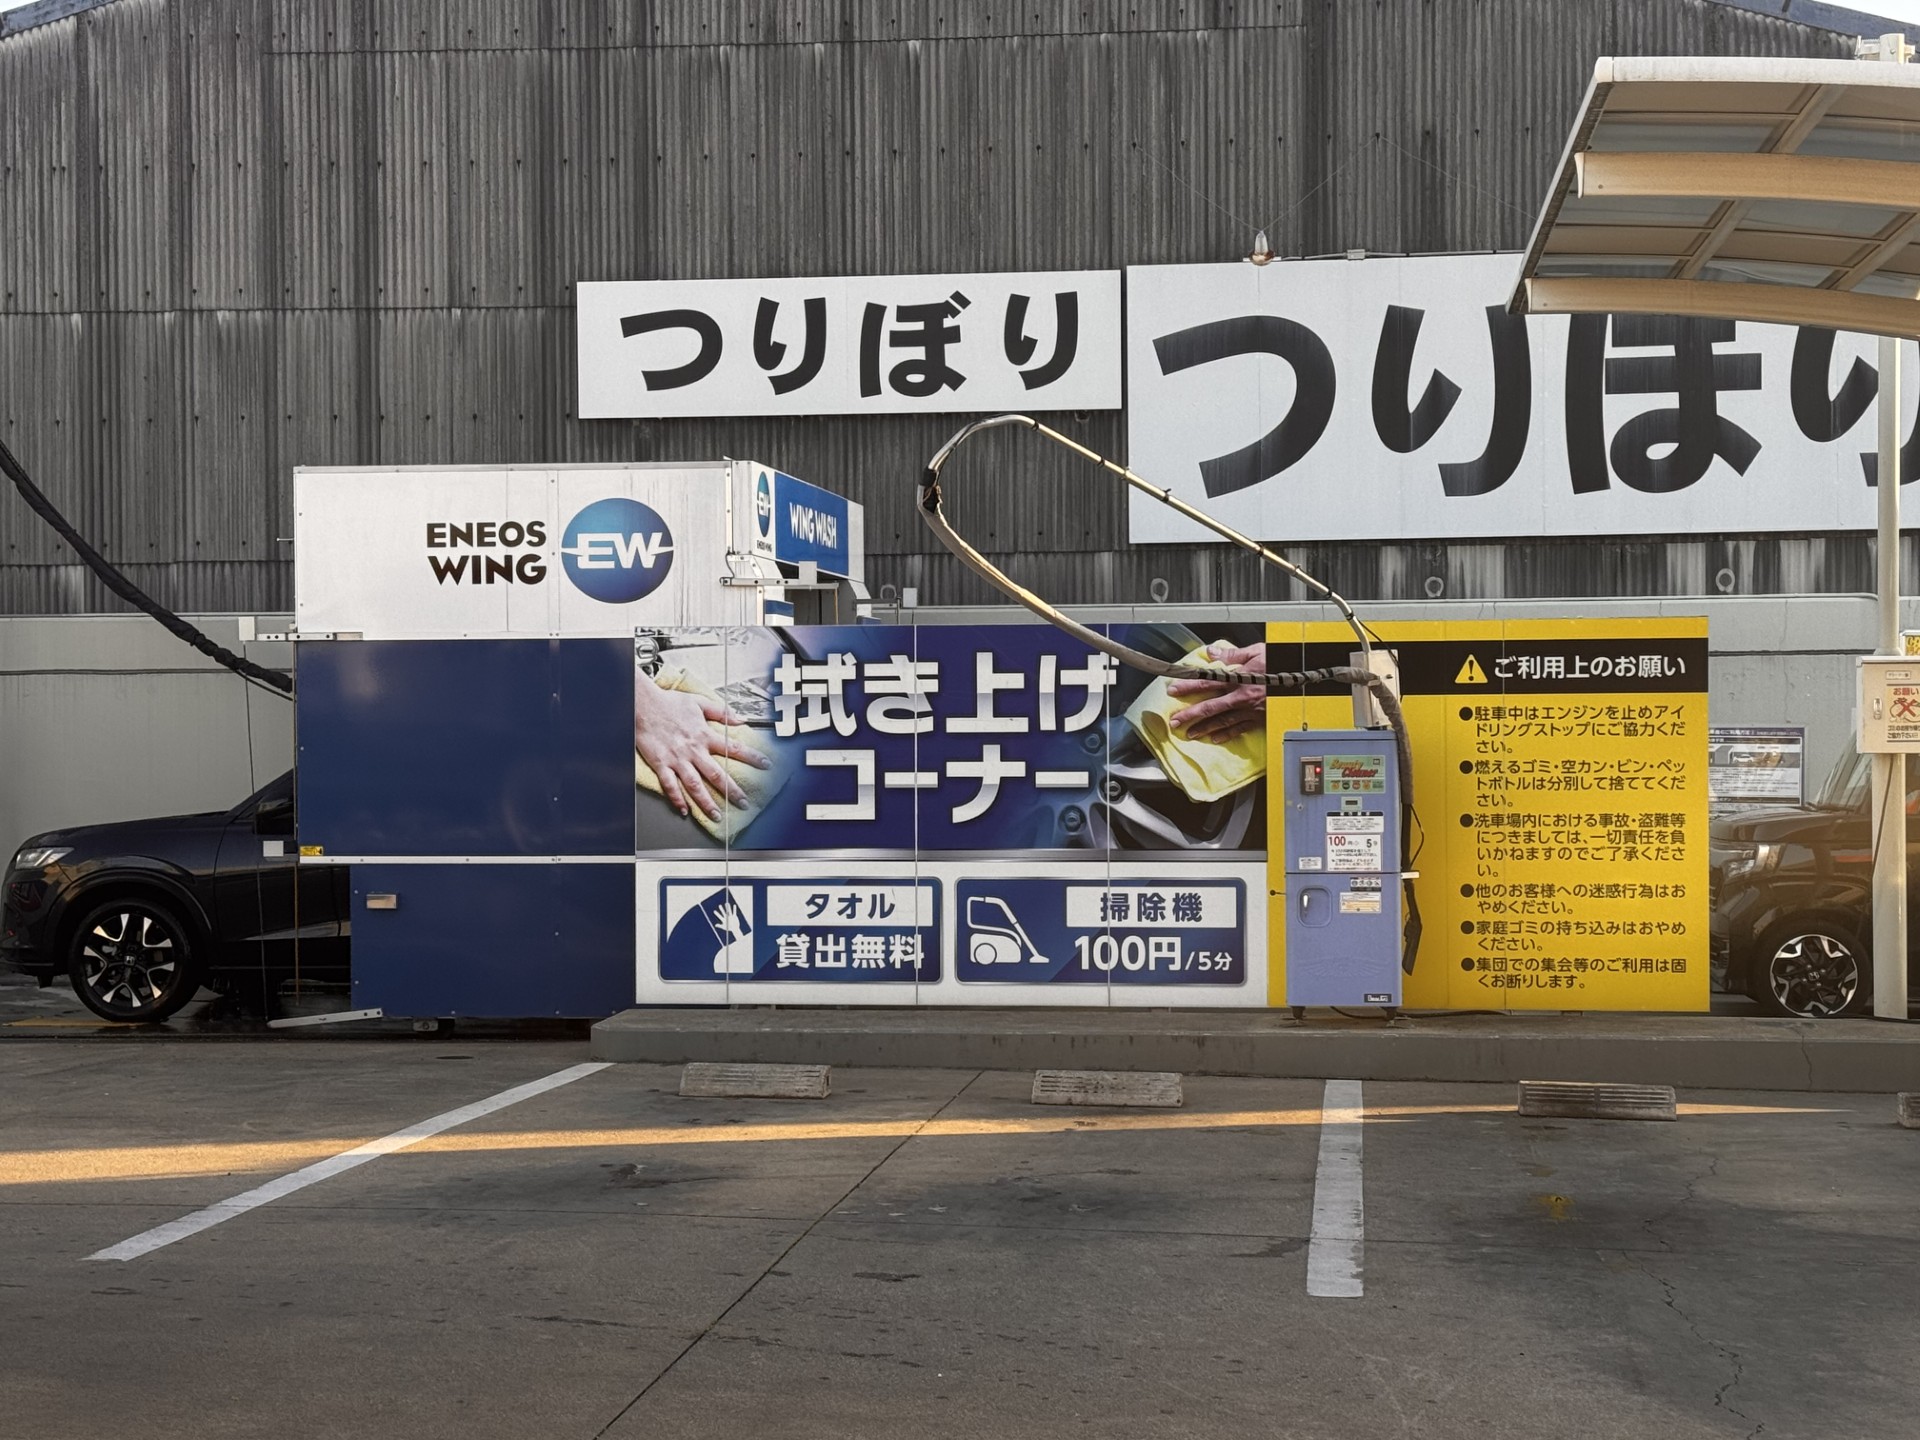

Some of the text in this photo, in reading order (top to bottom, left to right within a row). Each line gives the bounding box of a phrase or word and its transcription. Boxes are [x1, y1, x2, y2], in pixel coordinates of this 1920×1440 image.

[620, 290, 1079, 398] つりぼり
[789, 502, 837, 549] WING WASH
[427, 520, 547, 548] ENEOS
[575, 531, 666, 570] EW
[427, 554, 547, 585] WING
[1494, 655, 1686, 679] ご利用上のお願い
[774, 651, 1119, 737] 拭き上げ
[1474, 705, 1685, 721] 駐車中はエンジンを止めアイ
[1476, 722, 1686, 737] ドリングストップにご協力くだ
[1476, 740, 1513, 753] さい。
[806, 744, 1089, 823] コーナー
[1476, 776, 1686, 791] トボトルは分別して捨ててくだ
[1474, 813, 1686, 828] 洗車場内における事故・盗難等
[1476, 829, 1686, 845] につきましては、一切責任を負
[1477, 846, 1686, 861] いかねますのでご了承くださ
[1477, 864, 1499, 877] い。
[1476, 883, 1686, 899] 他のお客様への迷惑行為はお
[805, 893, 896, 920] タオル
[1100, 892, 1203, 923] 掃除機
[1477, 900, 1574, 915] やめください。
[1476, 920, 1687, 936] 家庭ゴミの持ち込みはおやめ
[776, 933, 925, 969] 貸出無料
[1477, 937, 1543, 952] ください。
[1476, 957, 1687, 973] 集団での集会等のご利用は固
[1478, 973, 1586, 989] くお断りします。
